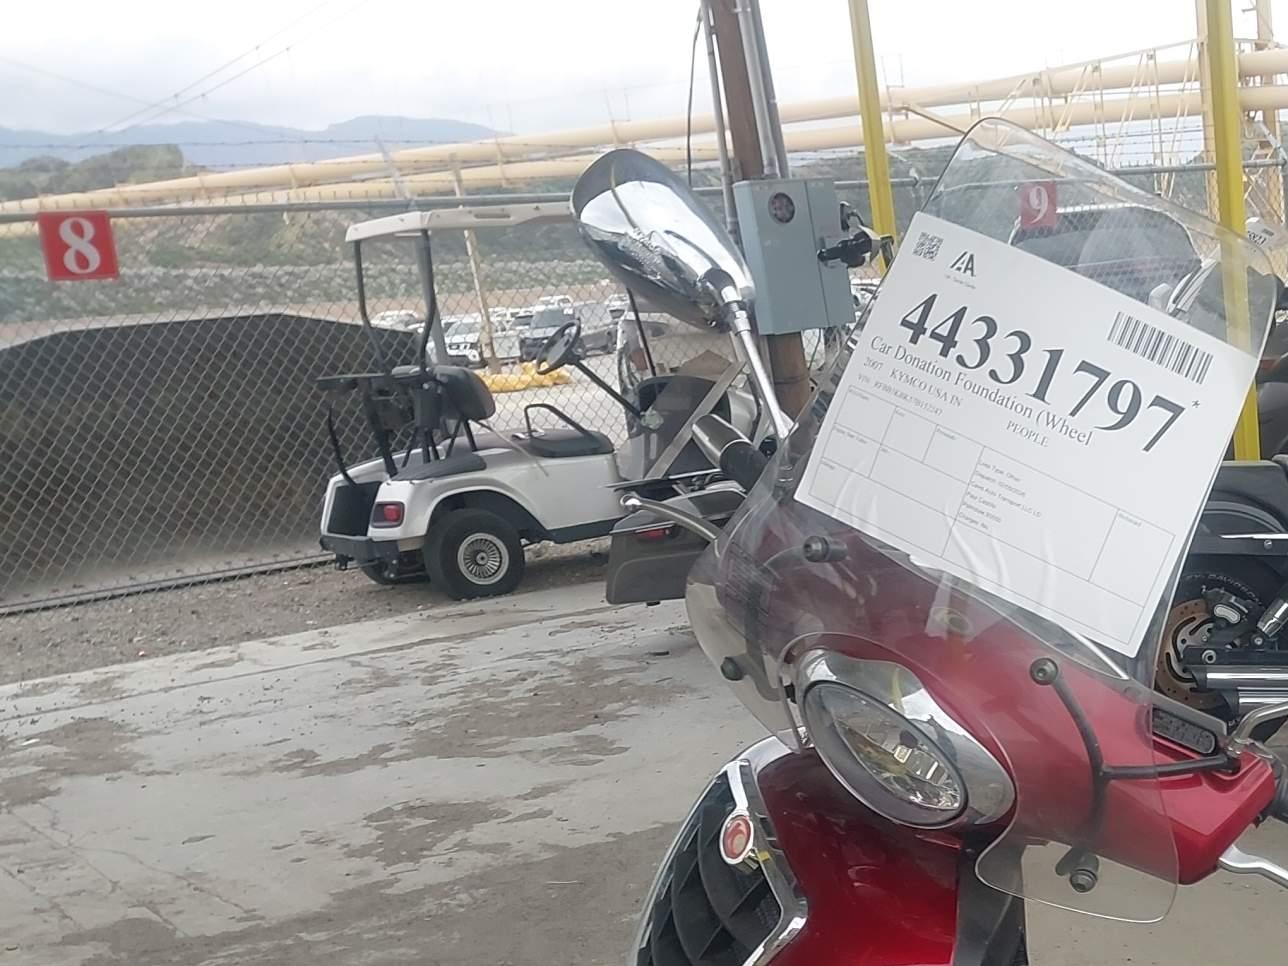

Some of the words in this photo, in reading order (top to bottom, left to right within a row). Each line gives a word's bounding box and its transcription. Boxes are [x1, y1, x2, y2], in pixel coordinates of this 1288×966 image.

[1029, 185, 1049, 224] 9
[59, 216, 101, 274] 8
[871, 336, 893, 356] Car
[894, 345, 952, 381] Donation
[954, 371, 1033, 419] Foundation
[1036, 408, 1093, 447] (Wheel
[889, 367, 927, 391] KYMCO
[928, 383, 948, 402] USA
[1006, 419, 1049, 448] PEOPLE
